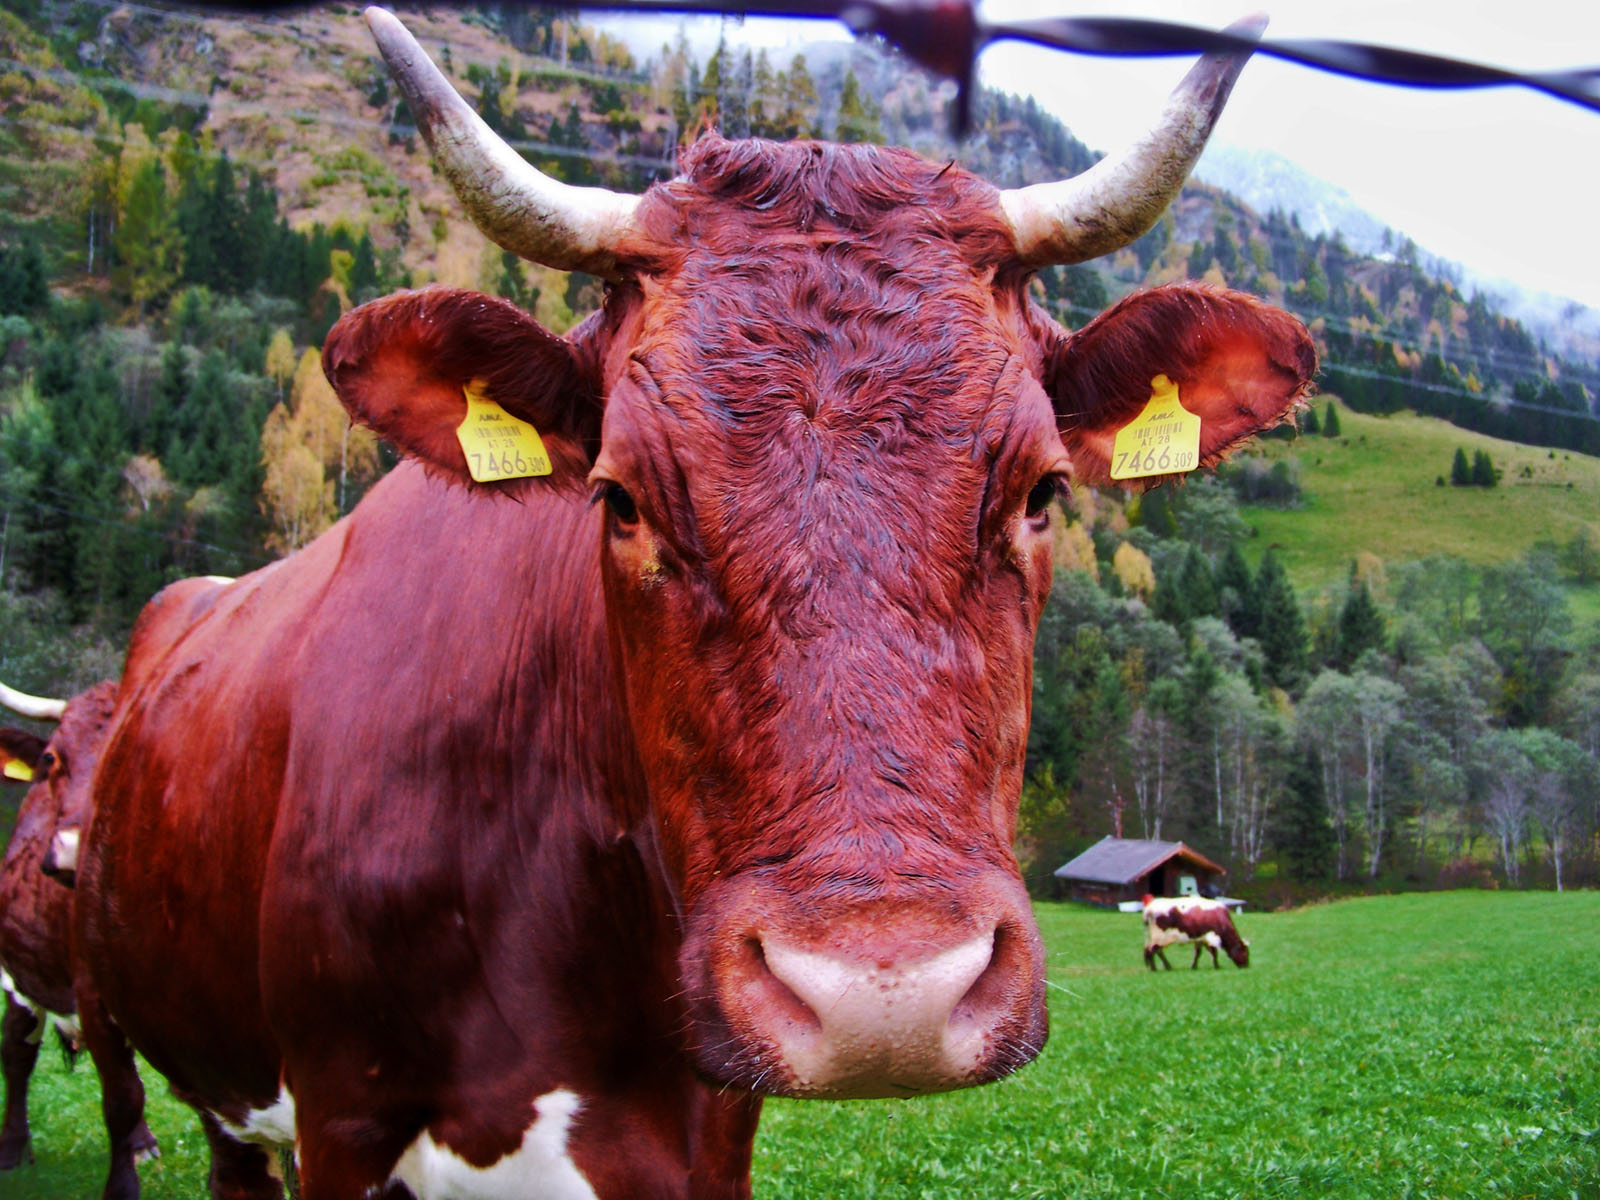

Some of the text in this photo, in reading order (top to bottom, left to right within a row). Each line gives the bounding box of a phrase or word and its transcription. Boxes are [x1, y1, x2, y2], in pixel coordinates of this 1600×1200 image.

[471, 450, 527, 480] 7466
[1114, 446, 1193, 475] 7466 309
